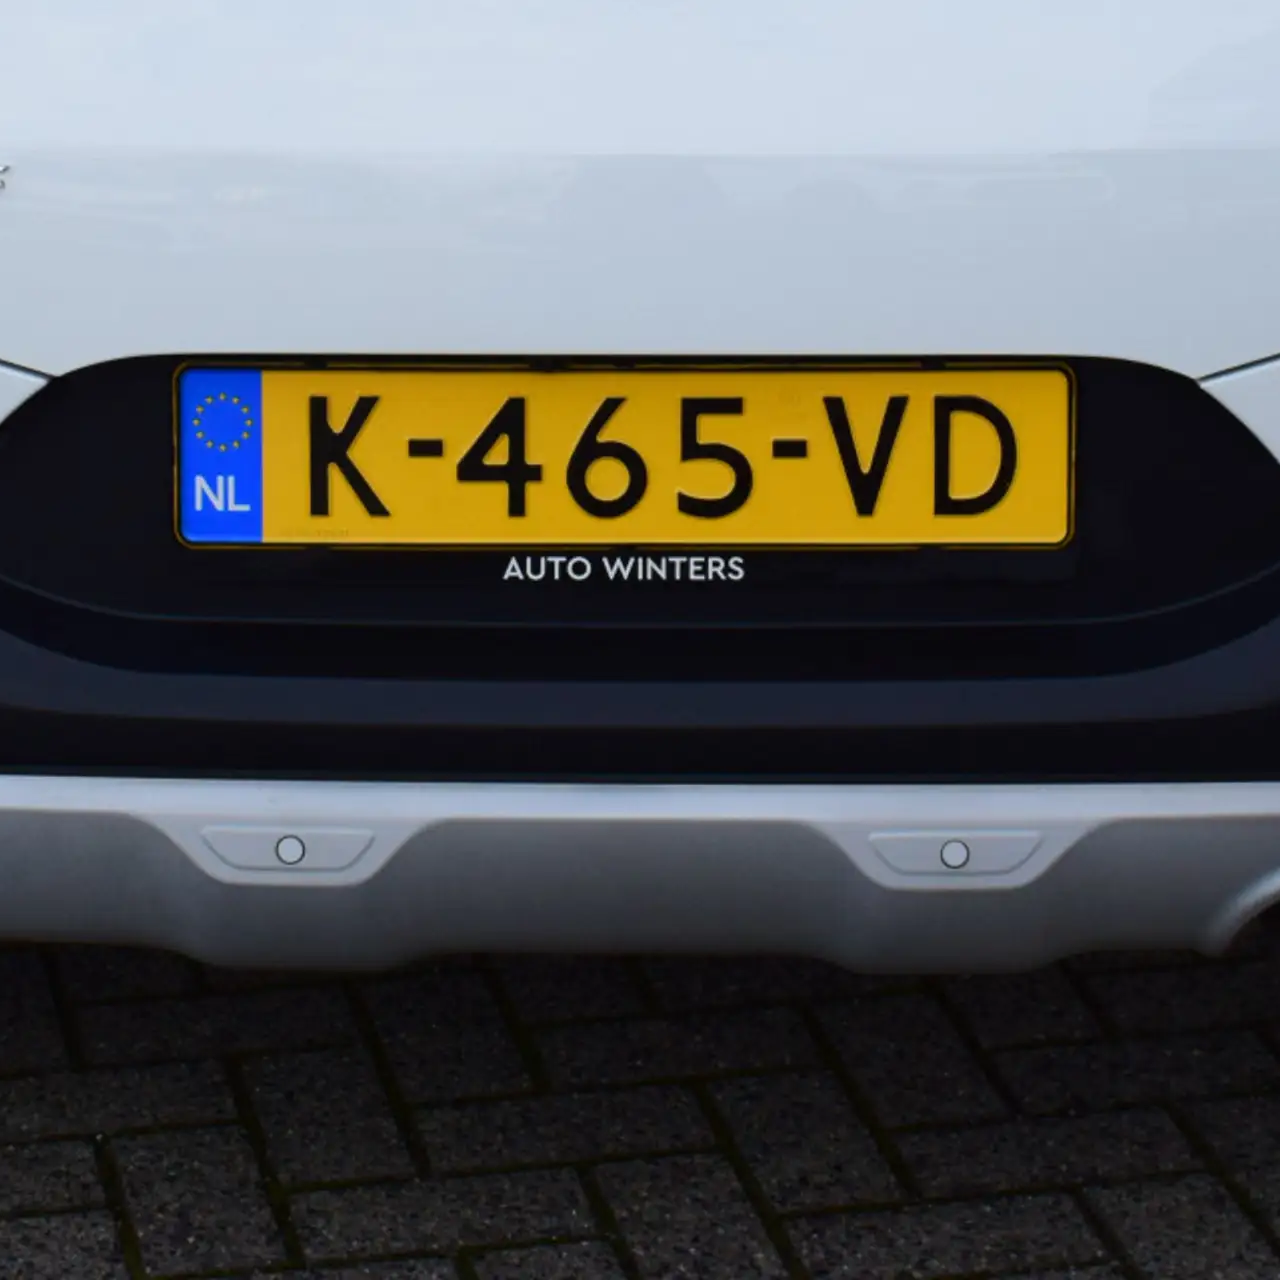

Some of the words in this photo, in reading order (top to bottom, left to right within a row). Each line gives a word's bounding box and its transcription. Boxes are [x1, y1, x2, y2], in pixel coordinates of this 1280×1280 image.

[308, 394, 1018, 519] K-465-VD
[194, 475, 251, 512] NL
[503, 556, 592, 581] AUTO
[601, 556, 745, 581] WINTERS
